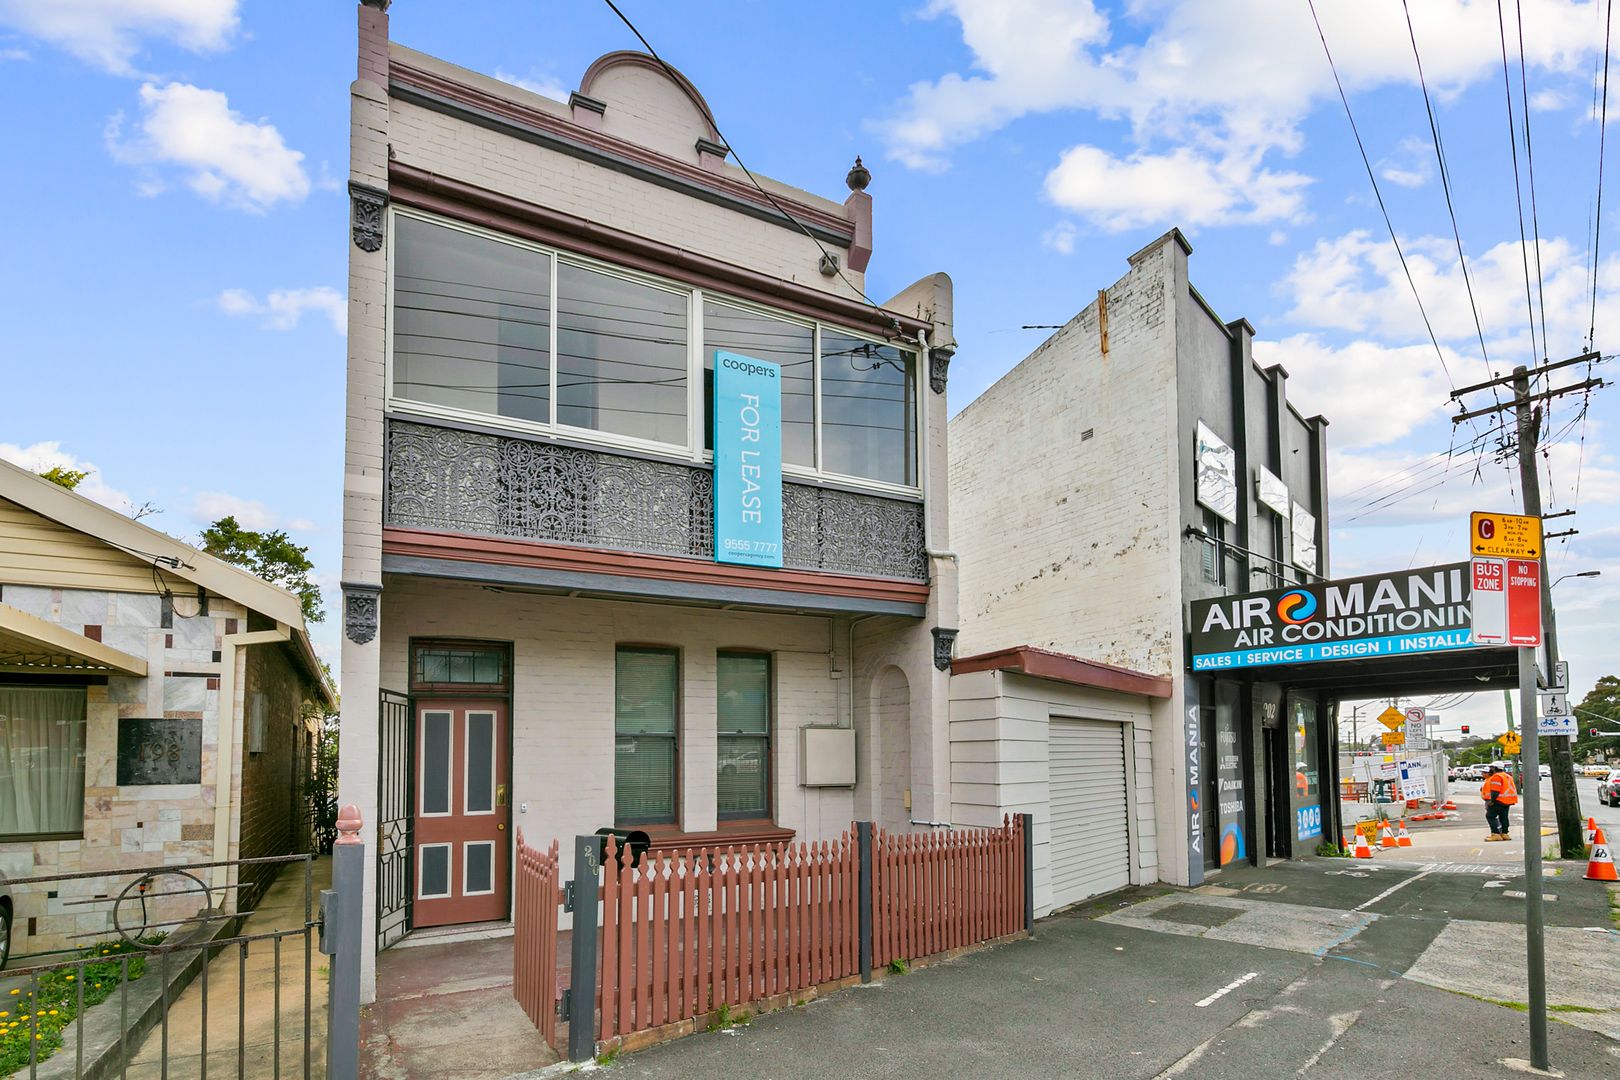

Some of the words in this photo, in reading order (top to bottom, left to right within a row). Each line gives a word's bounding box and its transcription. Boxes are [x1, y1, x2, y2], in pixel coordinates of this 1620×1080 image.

[723, 358, 776, 378] coopers
[740, 393, 760, 442] FOR
[741, 450, 762, 524] LEASE
[1481, 520, 1491, 538] C
[724, 538, 750, 551] 9555
[753, 541, 778, 553] 7777
[1487, 546, 1526, 555] CLEARWAY
[1476, 564, 1500, 576] BUS
[1518, 565, 1529, 574] NO
[1477, 578, 1500, 590] ZONE
[1510, 576, 1537, 587] STOPPING
[1201, 597, 1273, 633] AIR
[1325, 568, 1472, 618] MANI
[1234, 627, 1275, 648] AIR
[1281, 604, 1472, 643] CONDITIONIN
[1195, 655, 1232, 669] SALES
[1247, 649, 1303, 664] SERVICE
[1321, 641, 1380, 657] DESIGN
[1188, 706, 1199, 785] MANIA
[1219, 800, 1244, 815] TOSHIBA
[1191, 812, 1200, 853] AIR
